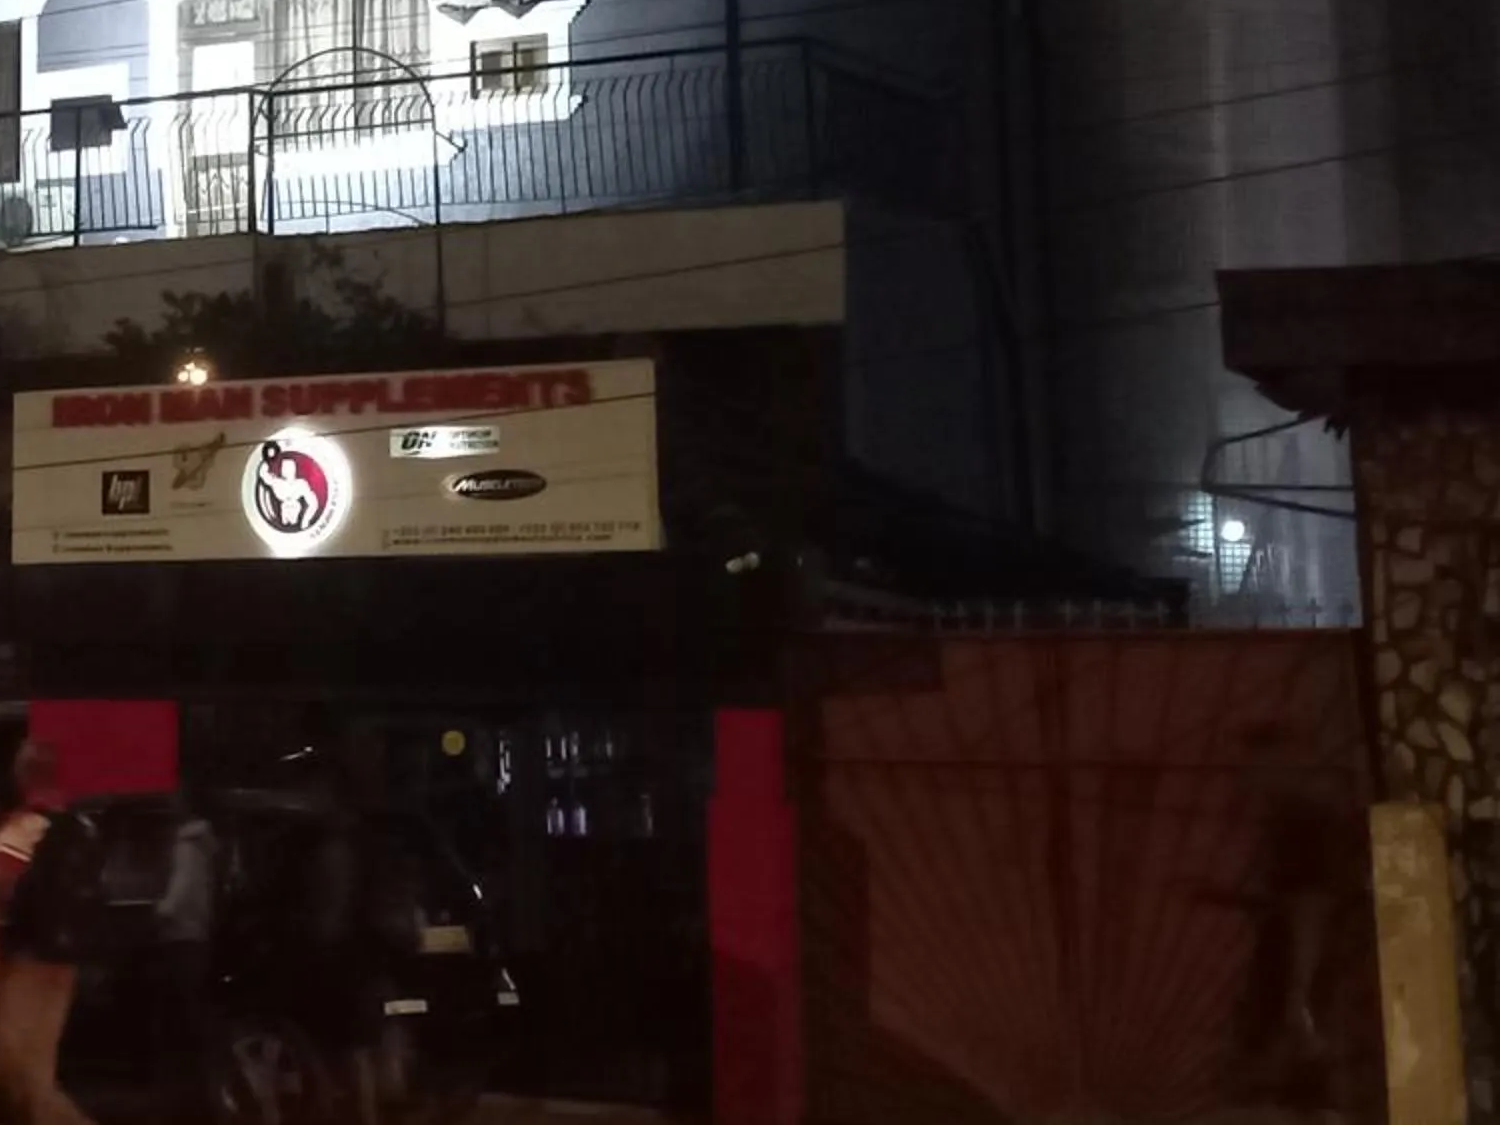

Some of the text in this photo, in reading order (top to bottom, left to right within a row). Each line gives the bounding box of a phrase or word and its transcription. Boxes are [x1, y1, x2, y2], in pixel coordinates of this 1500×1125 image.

[52, 368, 592, 428] IRON MAN SUPPLEMENTS
